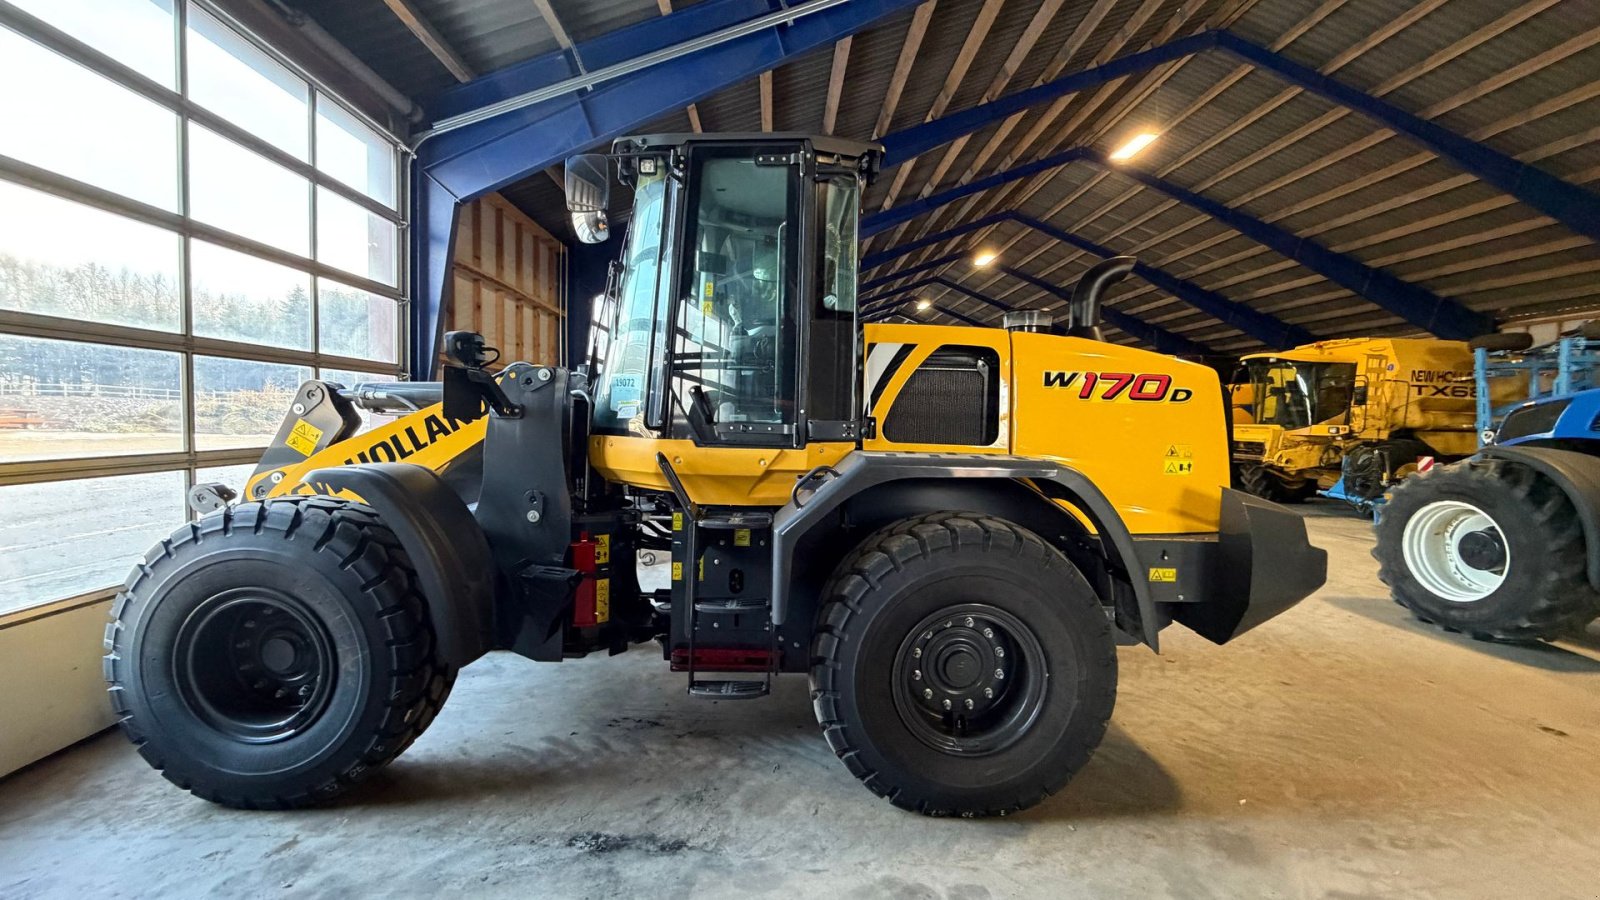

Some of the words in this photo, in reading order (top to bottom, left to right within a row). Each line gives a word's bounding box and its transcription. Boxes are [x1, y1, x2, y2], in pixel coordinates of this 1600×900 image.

[1411, 370, 1434, 383] NEW
[1437, 370, 1476, 383] HOLL
[344, 397, 490, 465] OLLA
